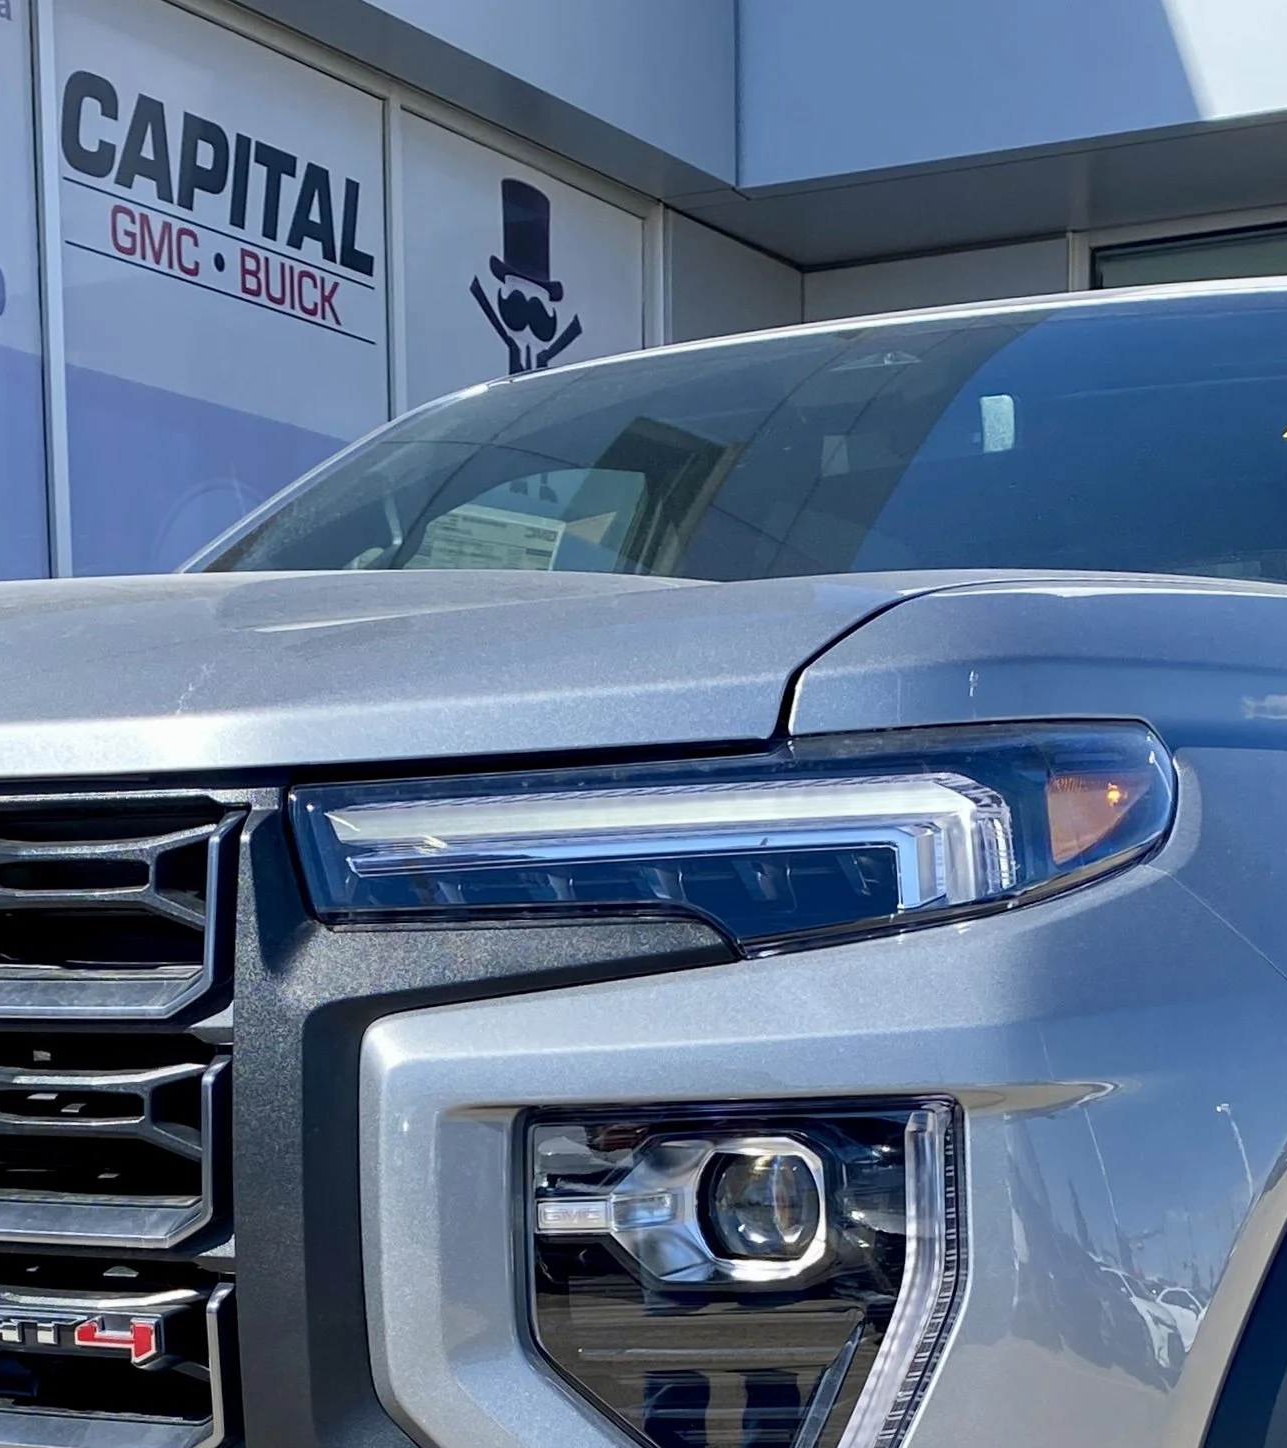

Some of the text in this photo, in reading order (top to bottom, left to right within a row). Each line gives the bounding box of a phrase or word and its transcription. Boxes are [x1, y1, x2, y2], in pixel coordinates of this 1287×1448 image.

[61, 70, 375, 278] CAPITAL
[111, 204, 342, 326] GMC BUICK
